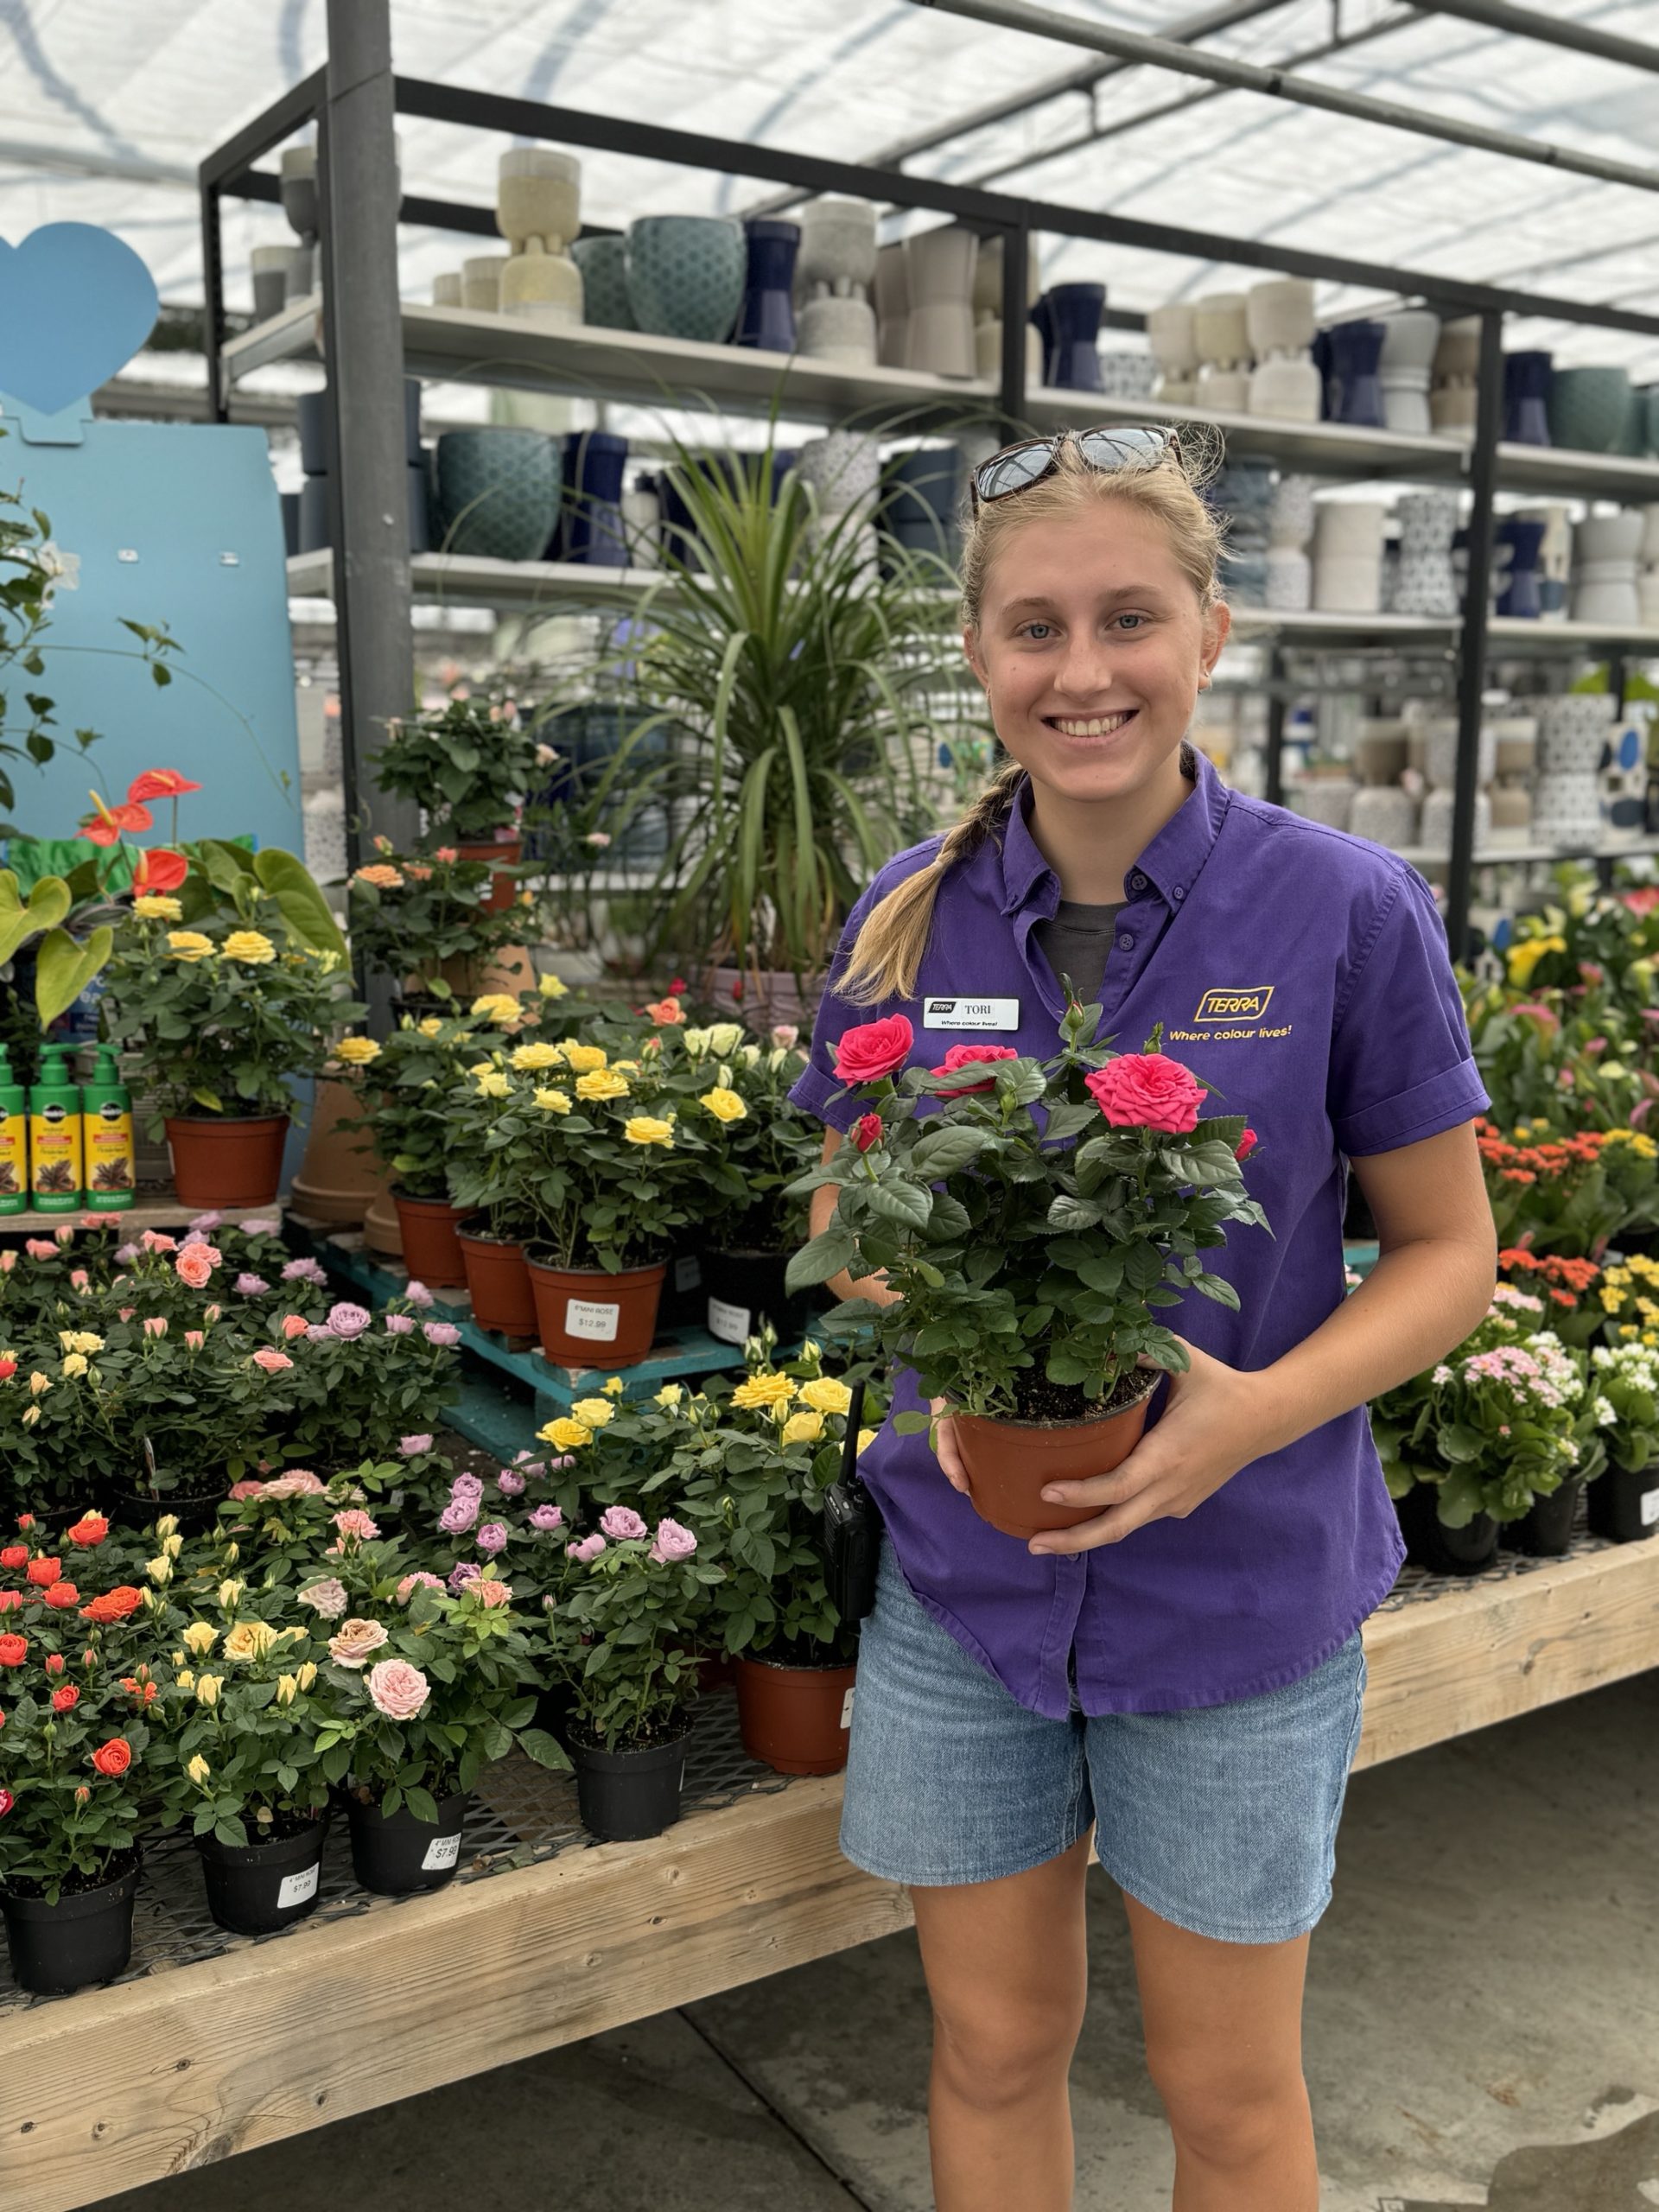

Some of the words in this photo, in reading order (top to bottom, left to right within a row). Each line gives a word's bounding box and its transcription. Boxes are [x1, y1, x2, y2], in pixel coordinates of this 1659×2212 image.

[964, 1005, 991, 1014] TORI
[1207, 996, 1259, 1013] TERRA
[1169, 1031, 1210, 1040] Where
[1214, 1029, 1255, 1039] colour
[1259, 1025, 1292, 1038] lives!
[579, 1319, 607, 1328] $12.99
[435, 1845, 457, 1859] $7.99
